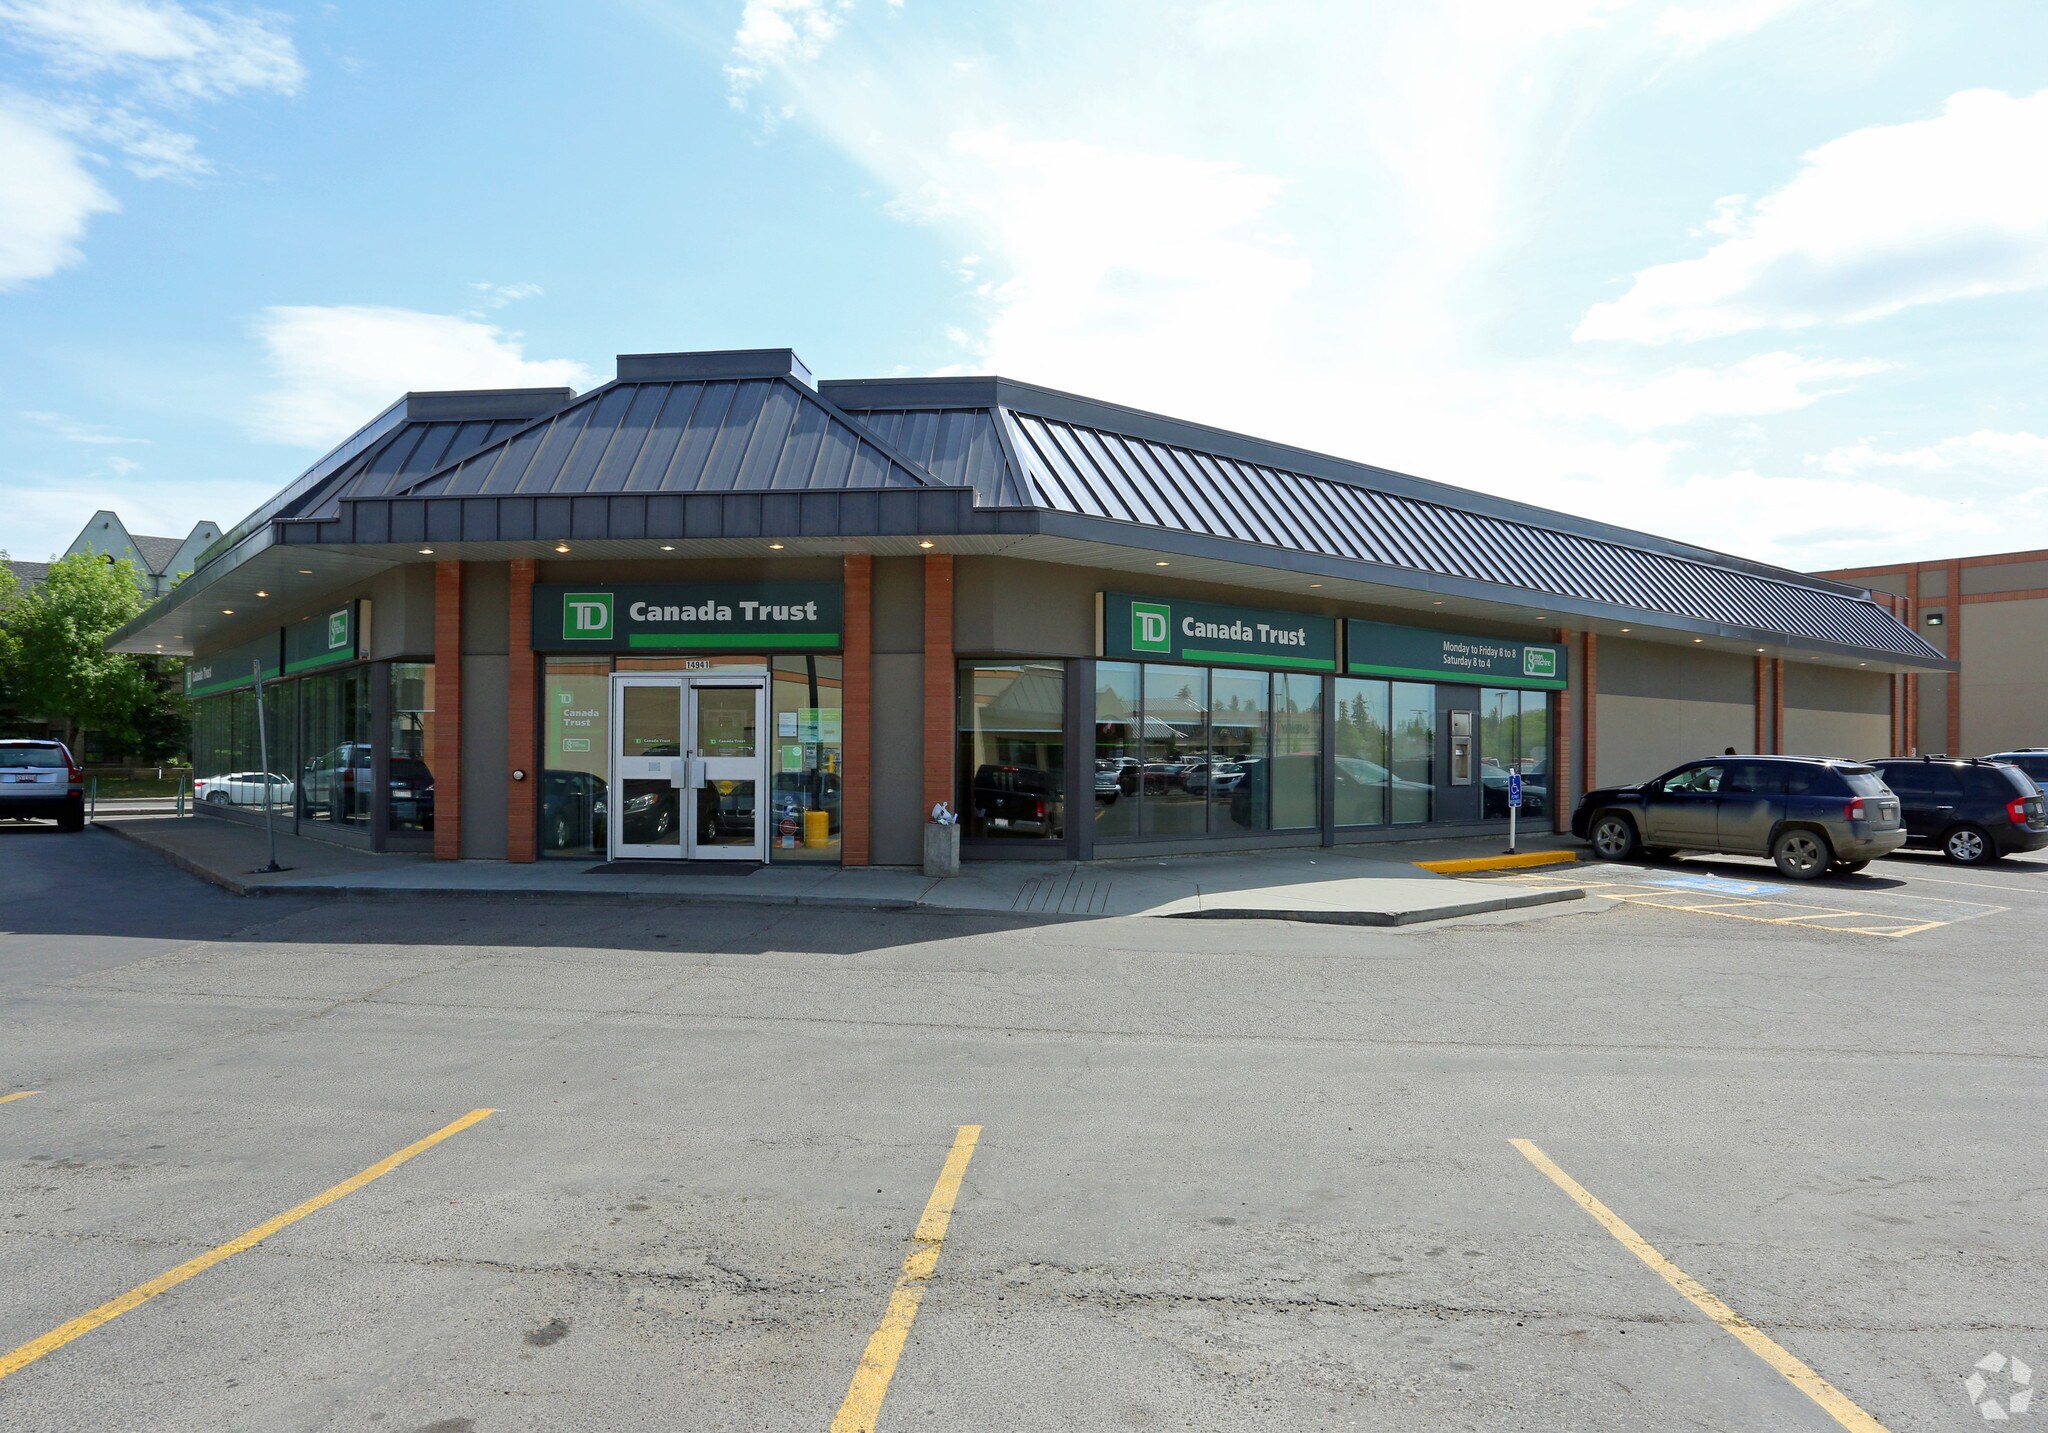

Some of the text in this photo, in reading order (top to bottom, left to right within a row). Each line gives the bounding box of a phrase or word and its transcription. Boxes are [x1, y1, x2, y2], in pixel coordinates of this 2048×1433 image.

[569, 600, 817, 630] TD Canada Trust
[1135, 611, 1306, 646] TD Canada Trust
[1443, 641, 1517, 658] Monday to Friday 8 to 8
[686, 661, 709, 669] 14941
[1443, 654, 1491, 668] Saturday 8 to 4
[558, 693, 572, 704] TD
[563, 709, 600, 717] Canada
[563, 719, 591, 727] Trust
